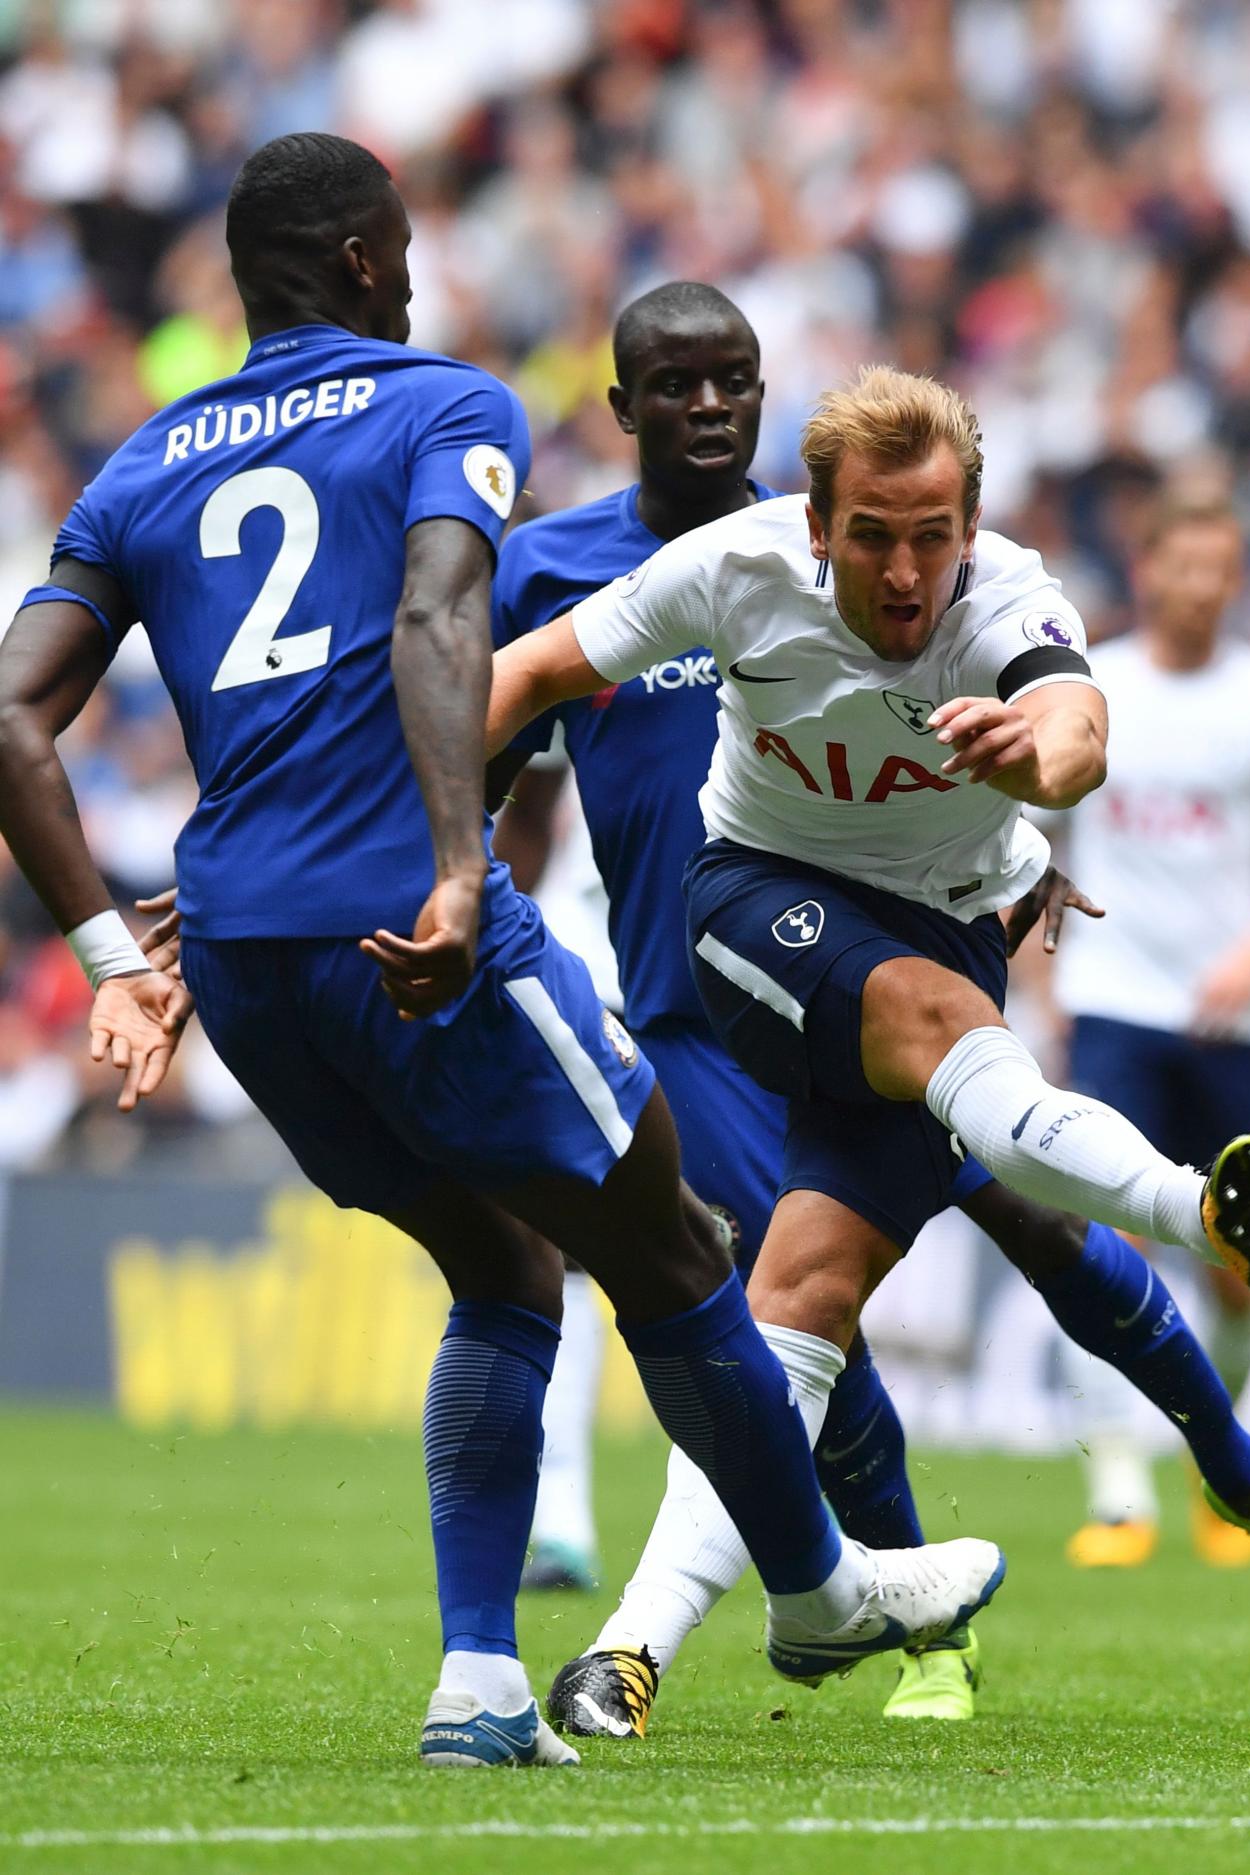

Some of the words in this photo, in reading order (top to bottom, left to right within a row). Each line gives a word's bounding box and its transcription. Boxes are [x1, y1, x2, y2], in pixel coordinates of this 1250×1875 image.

[163, 377, 376, 466] RÜDIGER
[199, 466, 333, 692] 2
[753, 728, 961, 803] AIA
